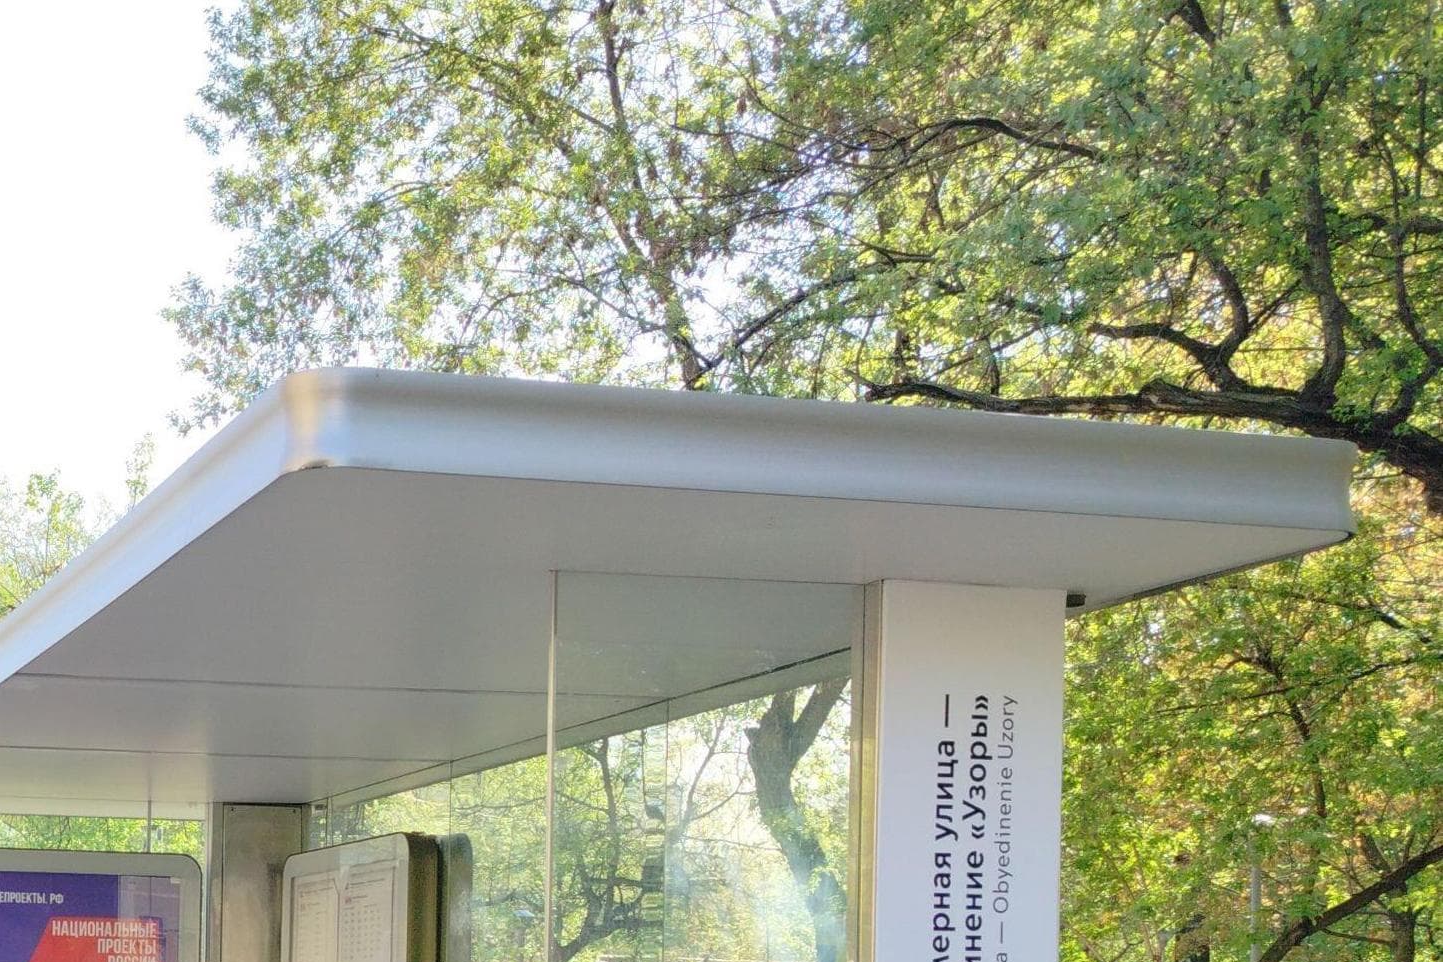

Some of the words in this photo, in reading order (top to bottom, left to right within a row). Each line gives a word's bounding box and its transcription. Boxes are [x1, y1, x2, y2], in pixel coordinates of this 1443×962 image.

[962, 694, 993, 839] «Узоры»
[997, 695, 1018, 759] Uzory
[935, 740, 958, 841] улица
[992, 767, 1013, 913] Obyedinenie
[51, 919, 157, 938] НАЦИОНАЛЬНЫЕ
[97, 938, 157, 955] ПРОЕКТЫ
